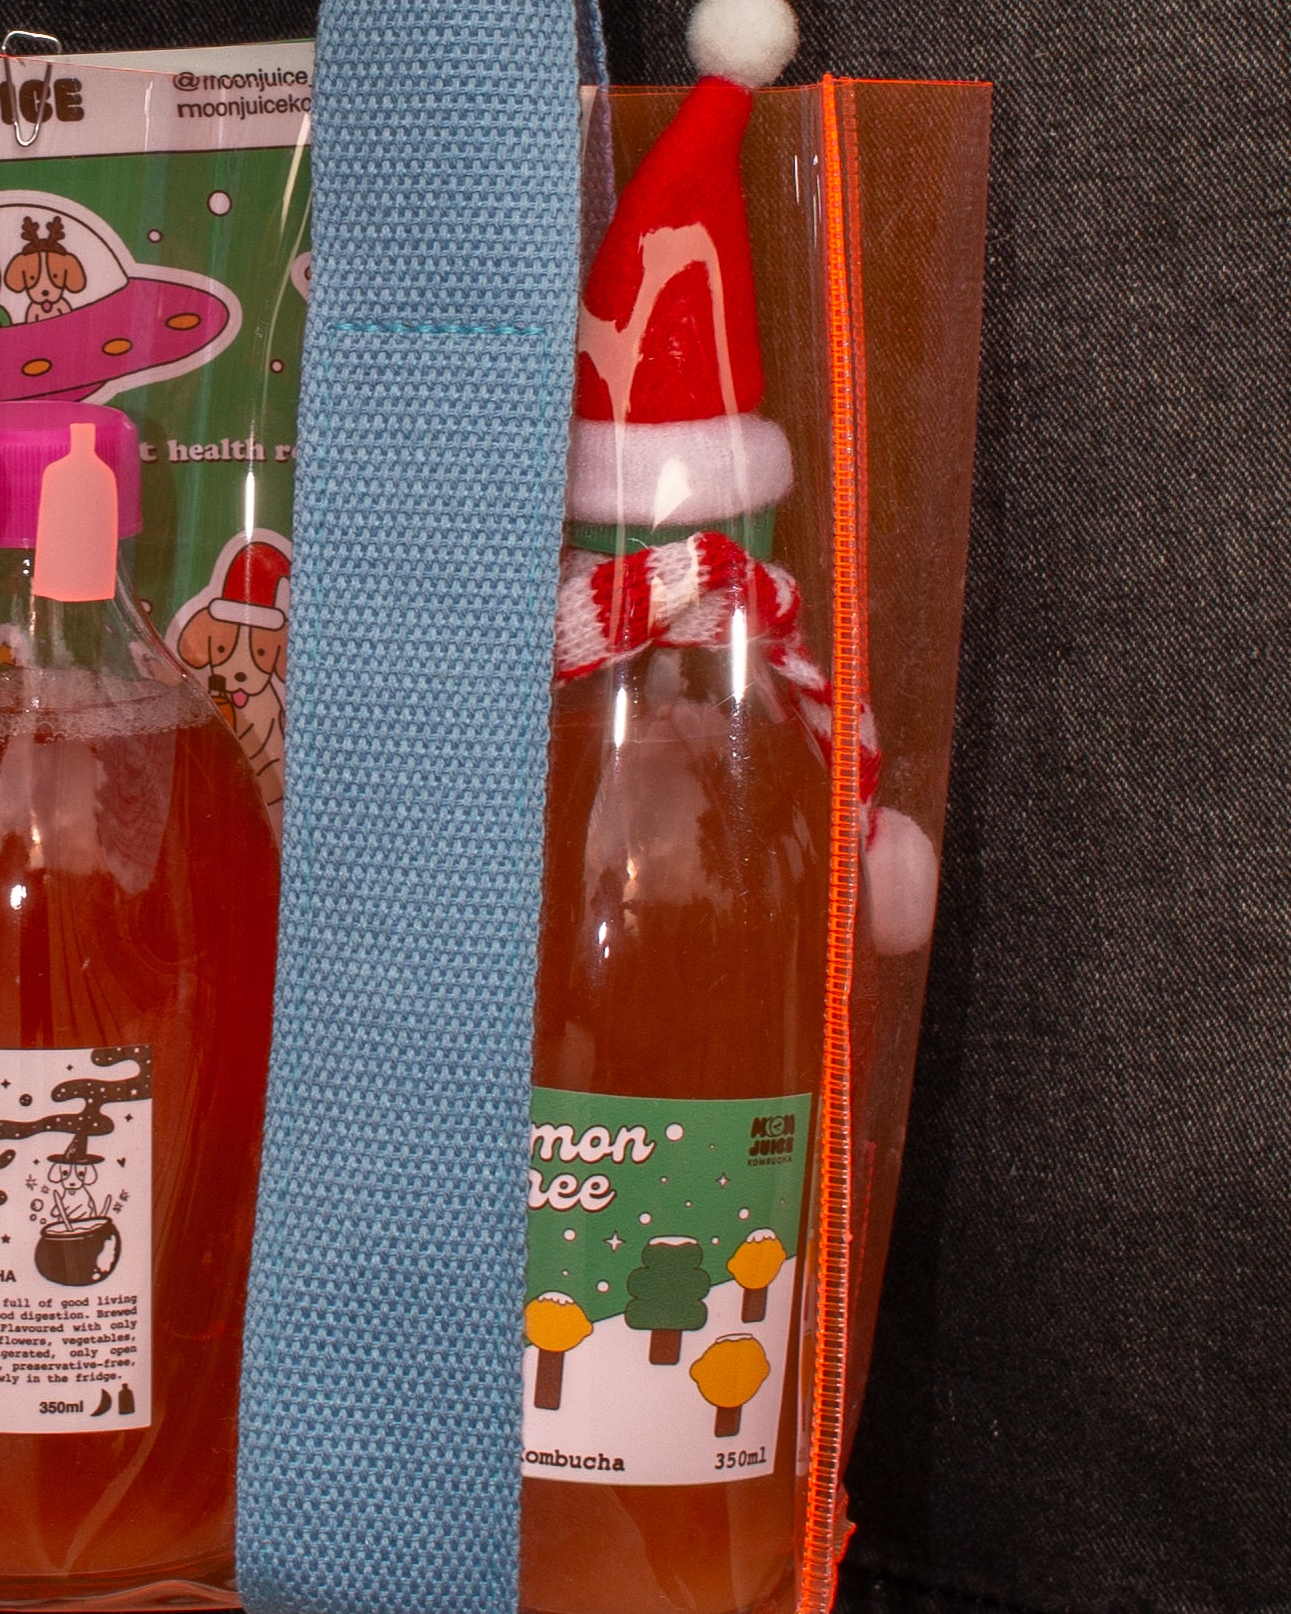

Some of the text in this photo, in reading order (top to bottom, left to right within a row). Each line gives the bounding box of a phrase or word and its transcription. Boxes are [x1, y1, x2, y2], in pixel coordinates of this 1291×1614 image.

[167, 437, 265, 463] health
[3, 1297, 30, 1308] full
[38, 1297, 53, 1308] of
[61, 1297, 90, 1310] good
[97, 1294, 138, 1306] living
[20, 1310, 90, 1322] digestion.
[96, 1307, 138, 1318] Brewed
[0, 1323, 64, 1333] Flavoured
[73, 1323, 102, 1332] with
[110, 1319, 138, 1331] only
[61, 1333, 136, 1347] vegetables,
[69, 1347, 99, 1359] only
[109, 1345, 138, 1357] open
[12, 1359, 136, 1373] preservative-free,
[26, 1372, 41, 1383] in
[47, 1372, 69, 1383] the
[75, 1370, 122, 1383] fridge.
[39, 1399, 84, 1415] 350ml
[714, 1446, 767, 1470] 350ml
